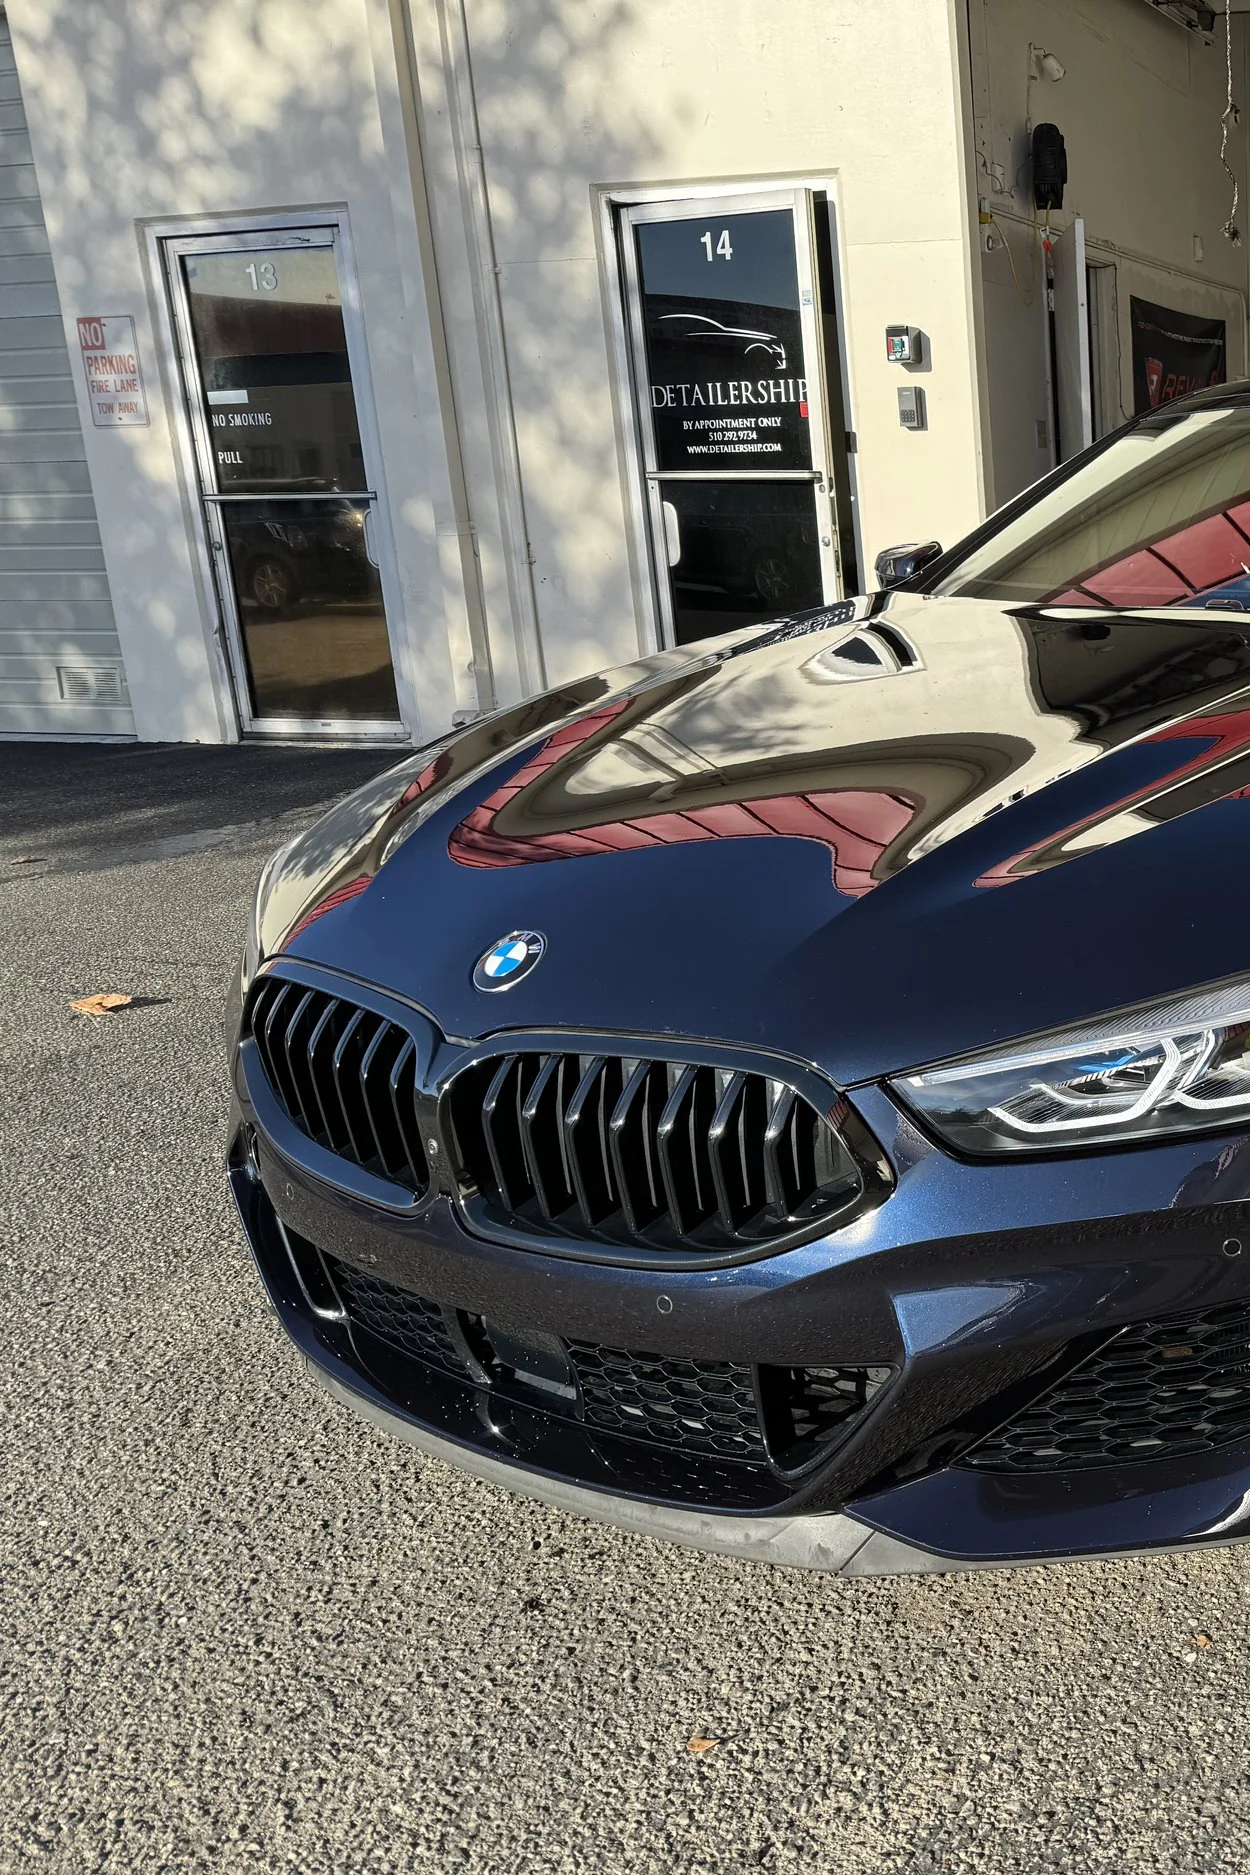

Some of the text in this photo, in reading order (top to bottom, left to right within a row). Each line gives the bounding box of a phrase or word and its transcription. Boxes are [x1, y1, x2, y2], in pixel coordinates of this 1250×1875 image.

[700, 229, 733, 262] 14
[245, 262, 278, 290] 13
[78, 322, 103, 347] NO
[85, 354, 137, 376] PARKING
[90, 379, 139, 394] FIRE LANE
[650, 378, 808, 408] DETAILERSHIP
[96, 401, 139, 414] TOW AWAY
[211, 412, 272, 427] NO SMOKING
[682, 416, 782, 430] BY APPOINTMENT ONLY
[708, 430, 758, 441] 510 292 9734
[686, 443, 782, 454] WWW.DETAILERSHIP.COM
[217, 451, 244, 464] PULL
